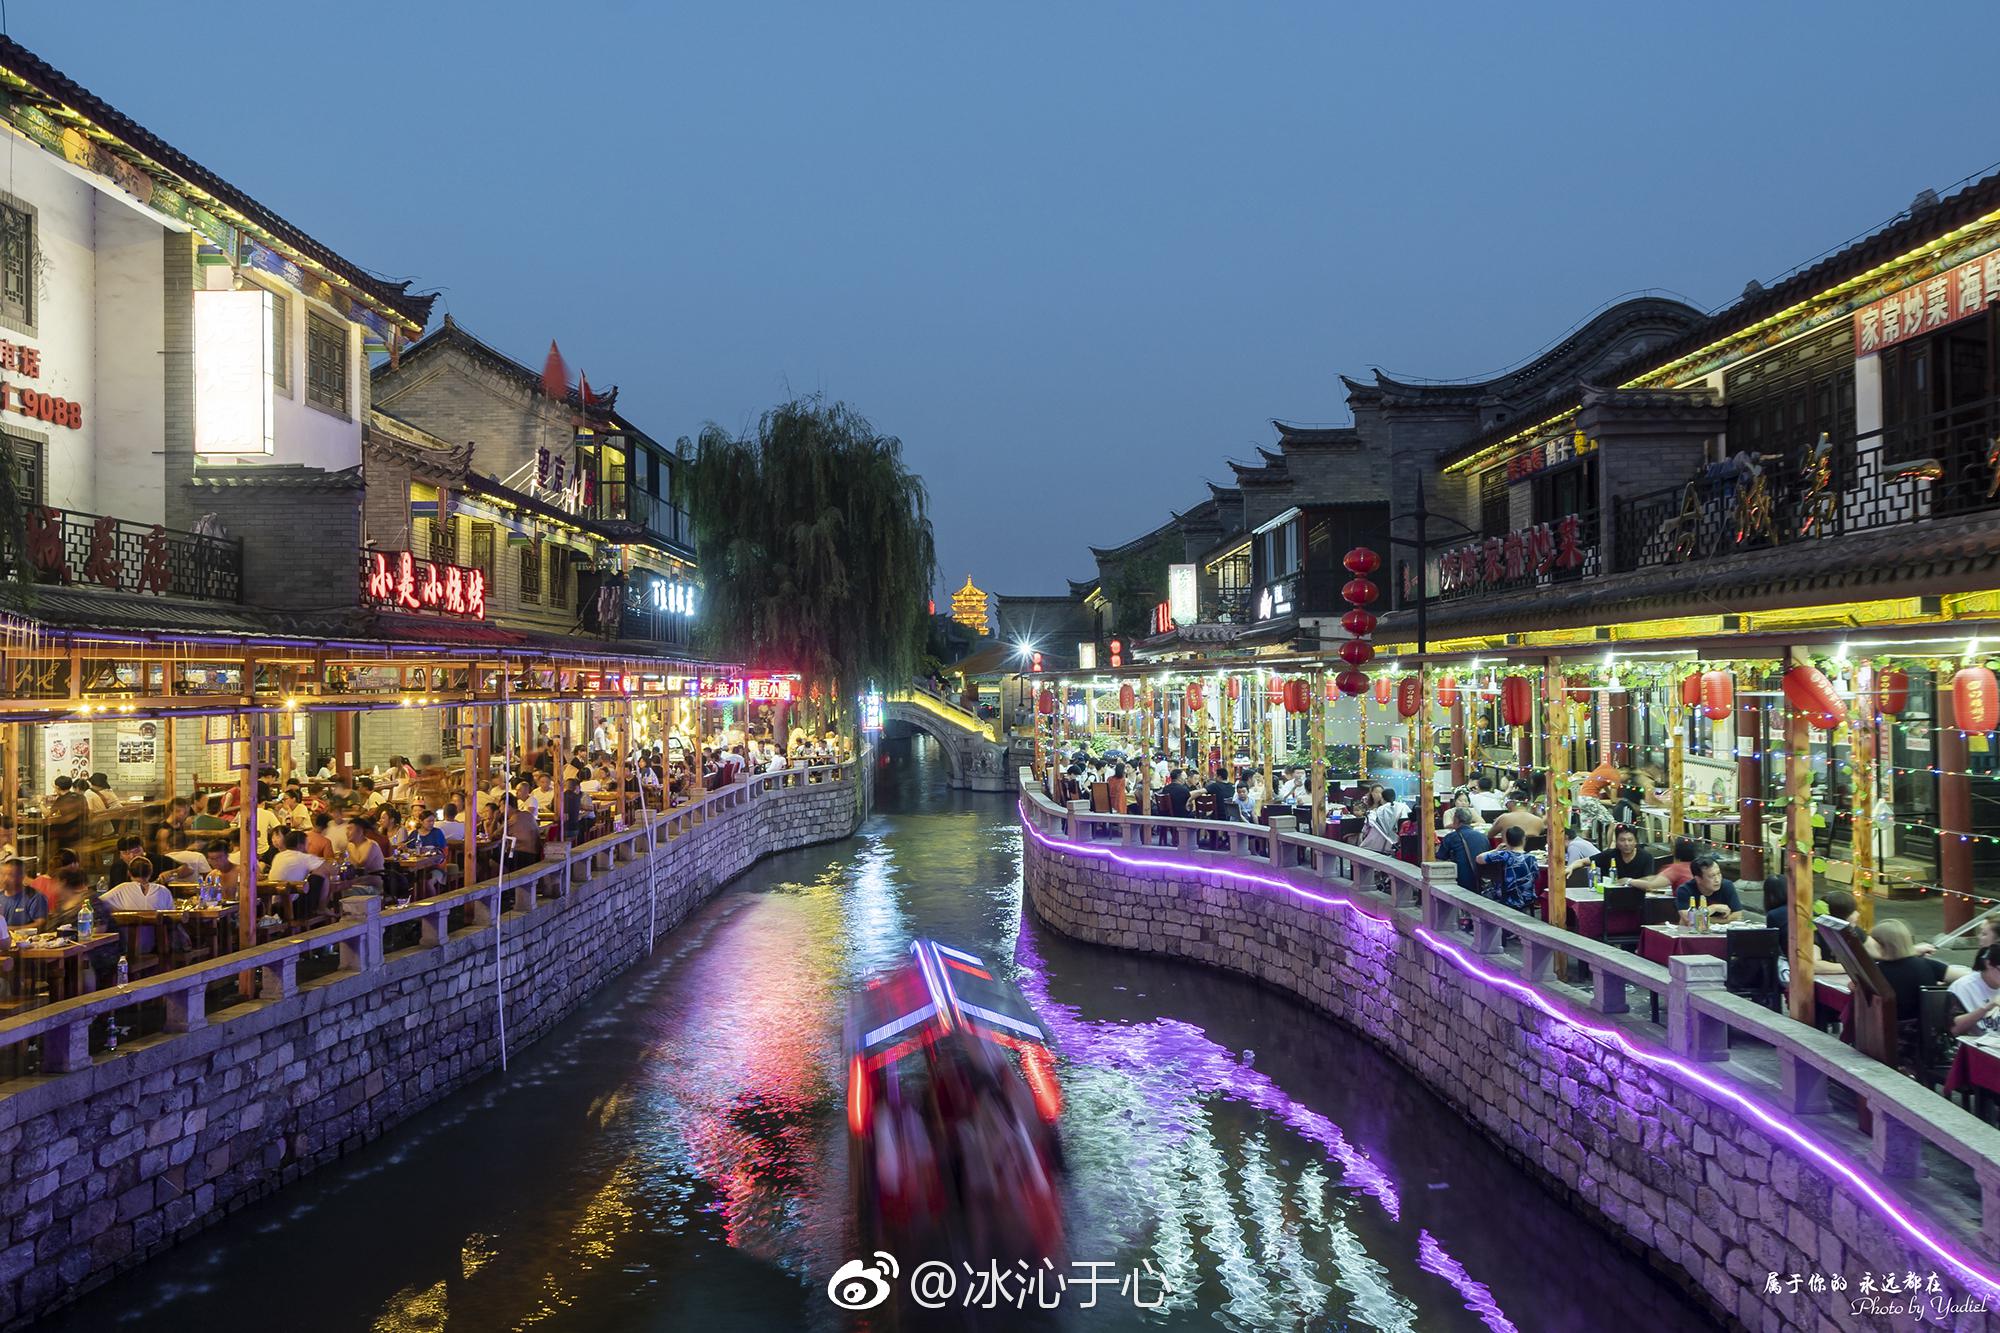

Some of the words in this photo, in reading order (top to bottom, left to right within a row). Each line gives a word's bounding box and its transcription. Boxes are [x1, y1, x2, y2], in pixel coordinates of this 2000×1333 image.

[1861, 278, 1949, 352] 家常炒菜
[0, 339, 42, 379] 电话
